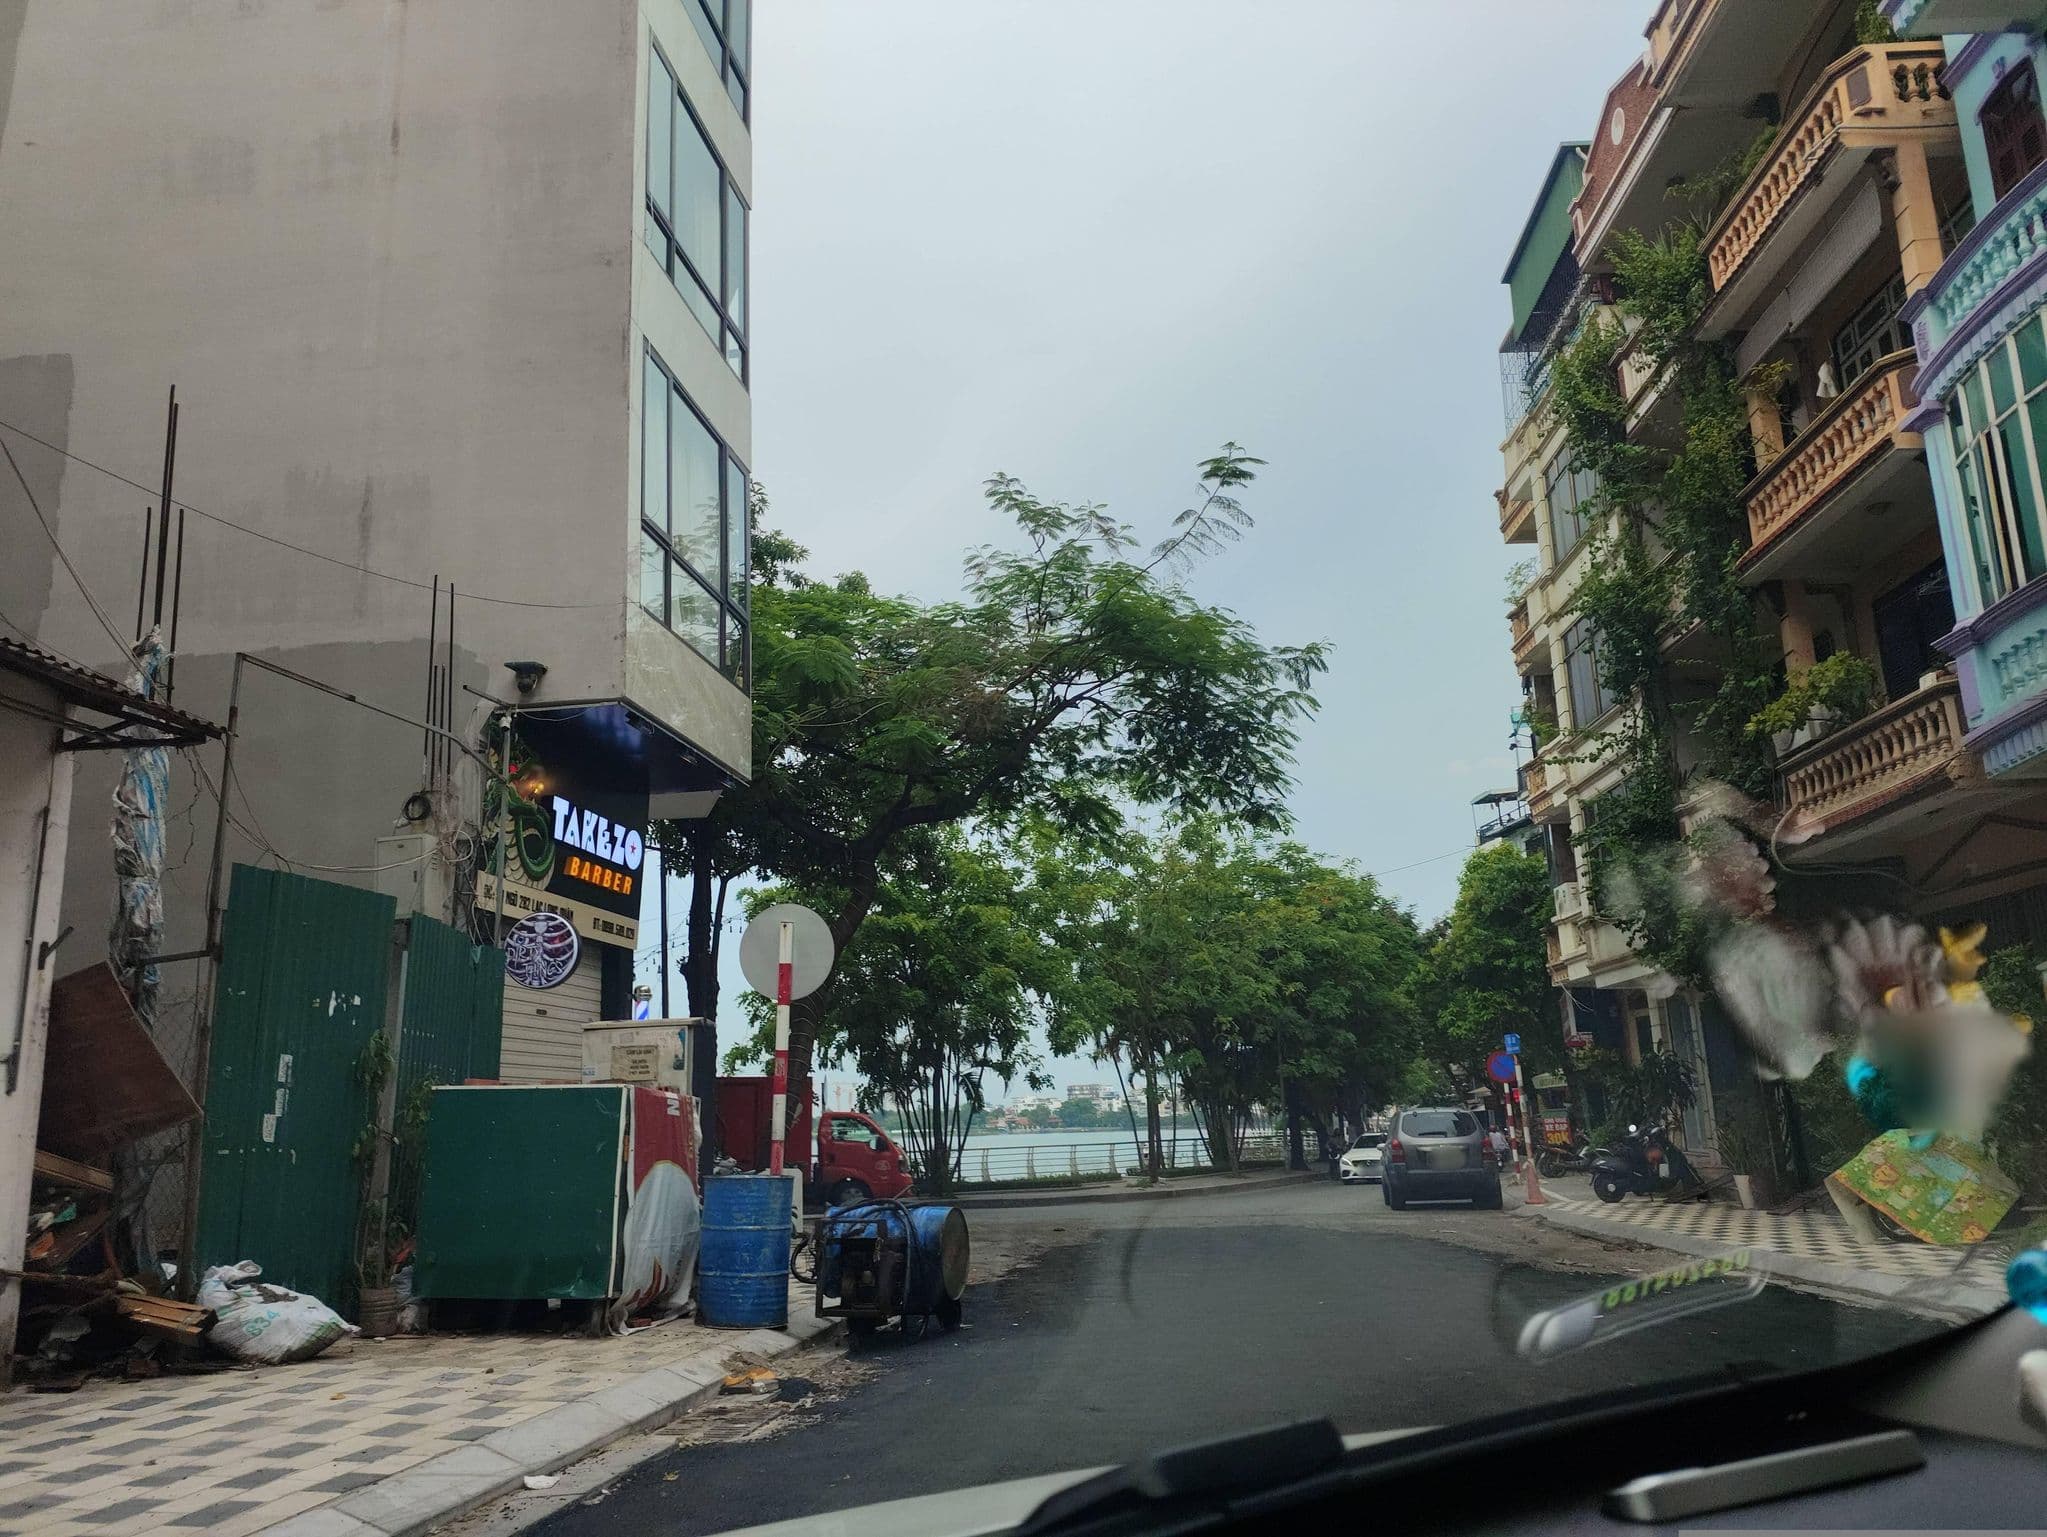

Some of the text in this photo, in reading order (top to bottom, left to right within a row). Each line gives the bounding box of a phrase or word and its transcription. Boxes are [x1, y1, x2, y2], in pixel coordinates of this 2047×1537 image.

[552, 795, 642, 870] TAKEZO
[570, 856, 633, 895] BARBER
[1547, 1131, 1569, 1145] 30K
